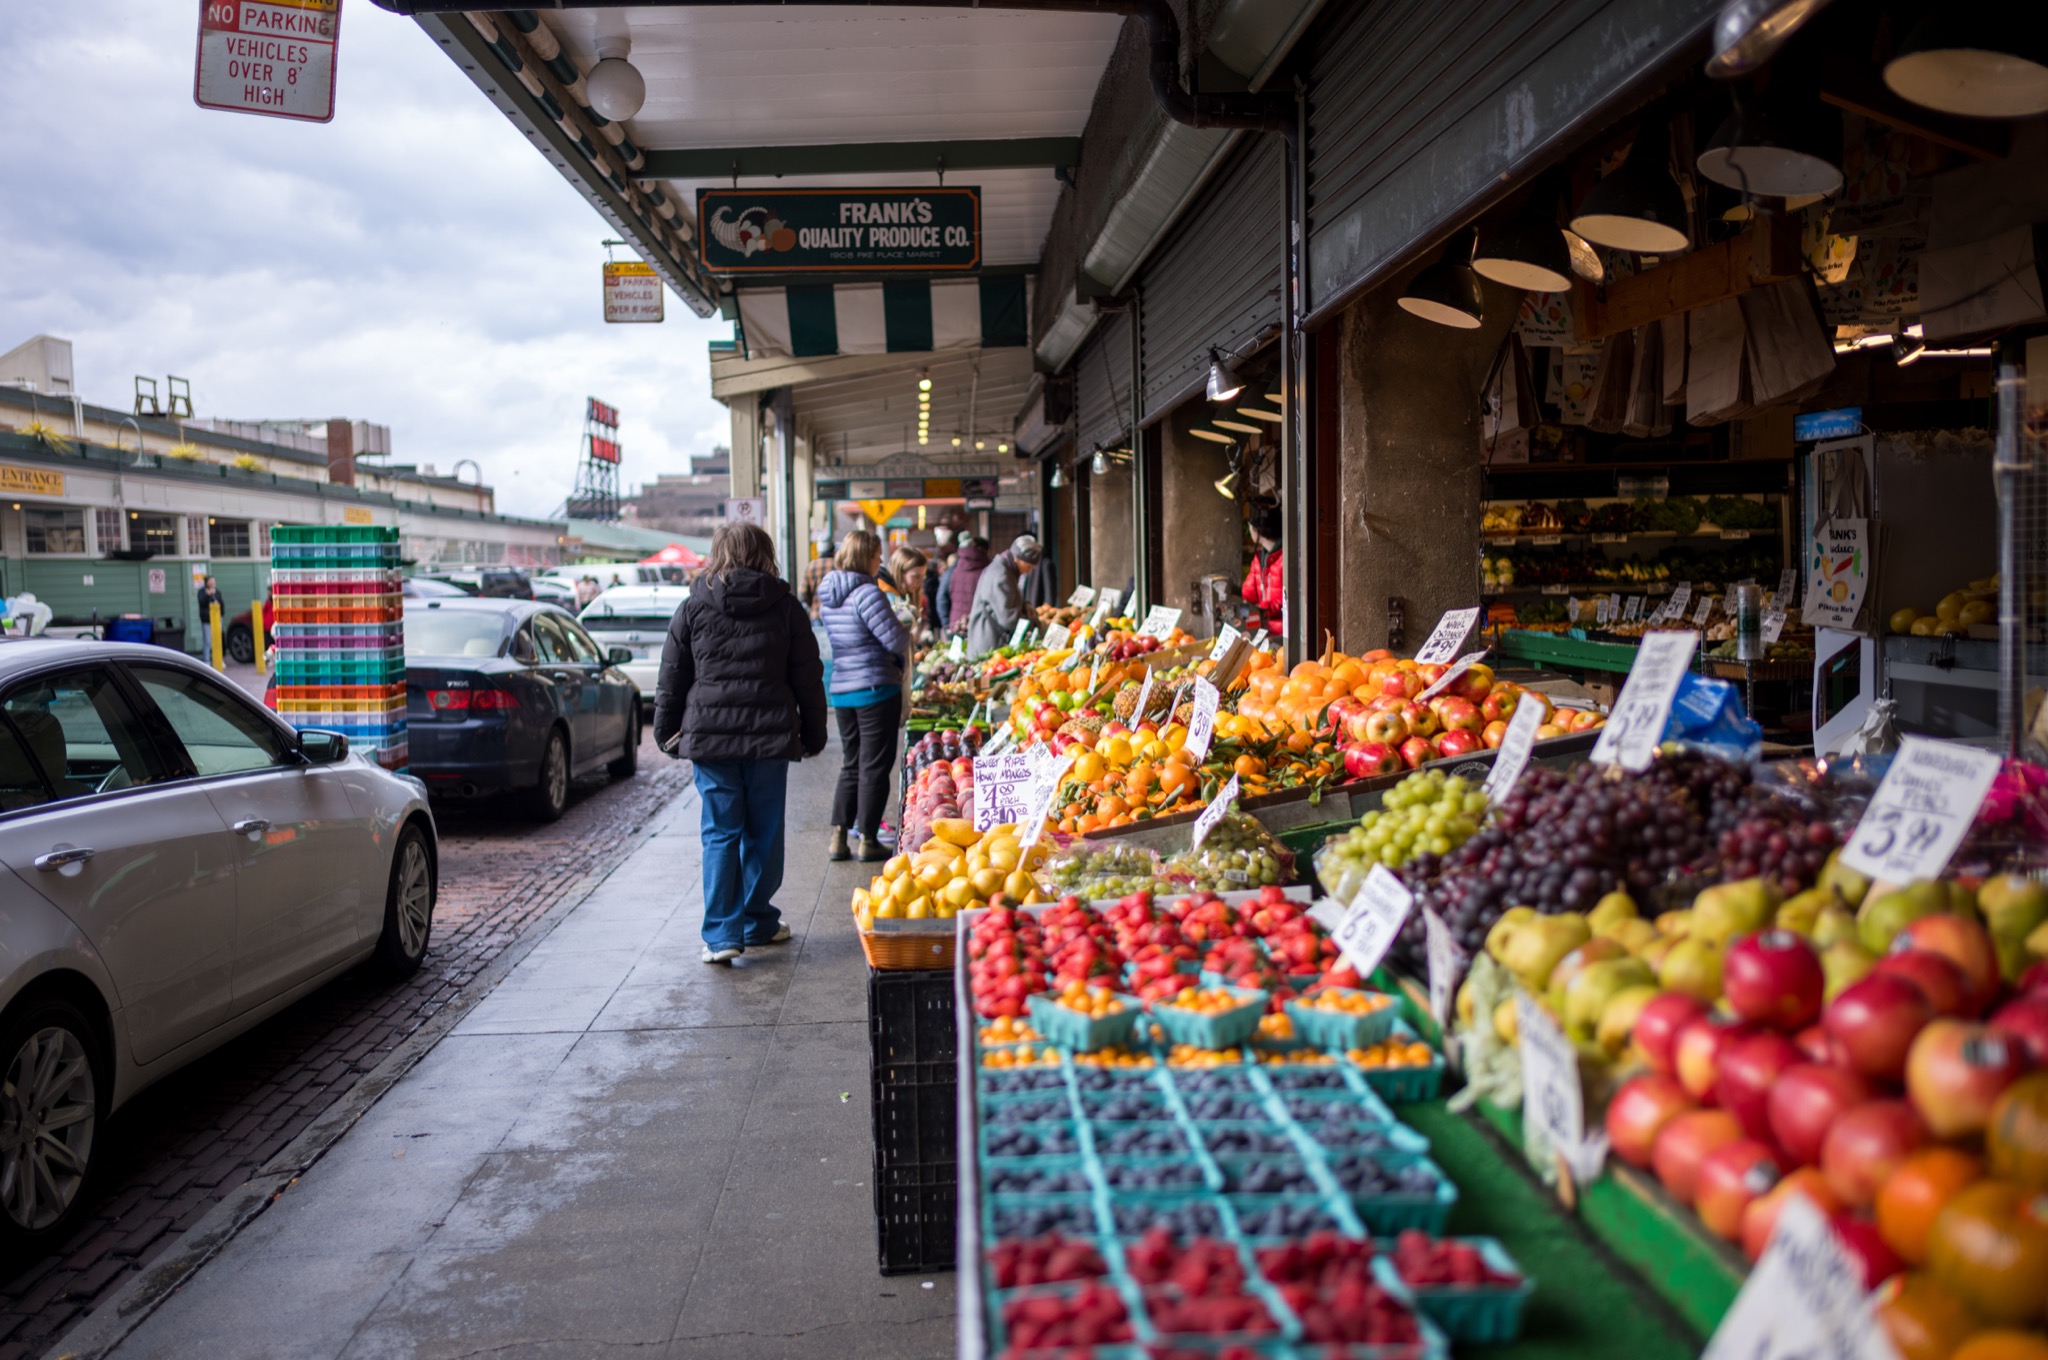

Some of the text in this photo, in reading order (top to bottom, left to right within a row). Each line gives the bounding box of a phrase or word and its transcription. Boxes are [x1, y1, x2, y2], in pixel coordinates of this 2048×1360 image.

[207, 5, 331, 36] NO PARKING
[226, 37, 308, 64] VEHICLES
[228, 60, 273, 83] OVER
[244, 84, 285, 106] HIGH
[839, 197, 933, 225] FRANK'S
[799, 225, 971, 250] QUALITY PRODUCE CO.
[877, 251, 905, 259] PLACE
[907, 250, 942, 259] MARKET
[614, 290, 653, 300] VEHICLES
[607, 305, 629, 314] OVER
[883, 465, 930, 477] PUBLIC
[937, 464, 995, 476] MARKET
[975, 756, 1027, 769] SWEET RIPE
[975, 768, 1032, 784] HONEY MANGOS
[1000, 796, 1020, 806] EACH
